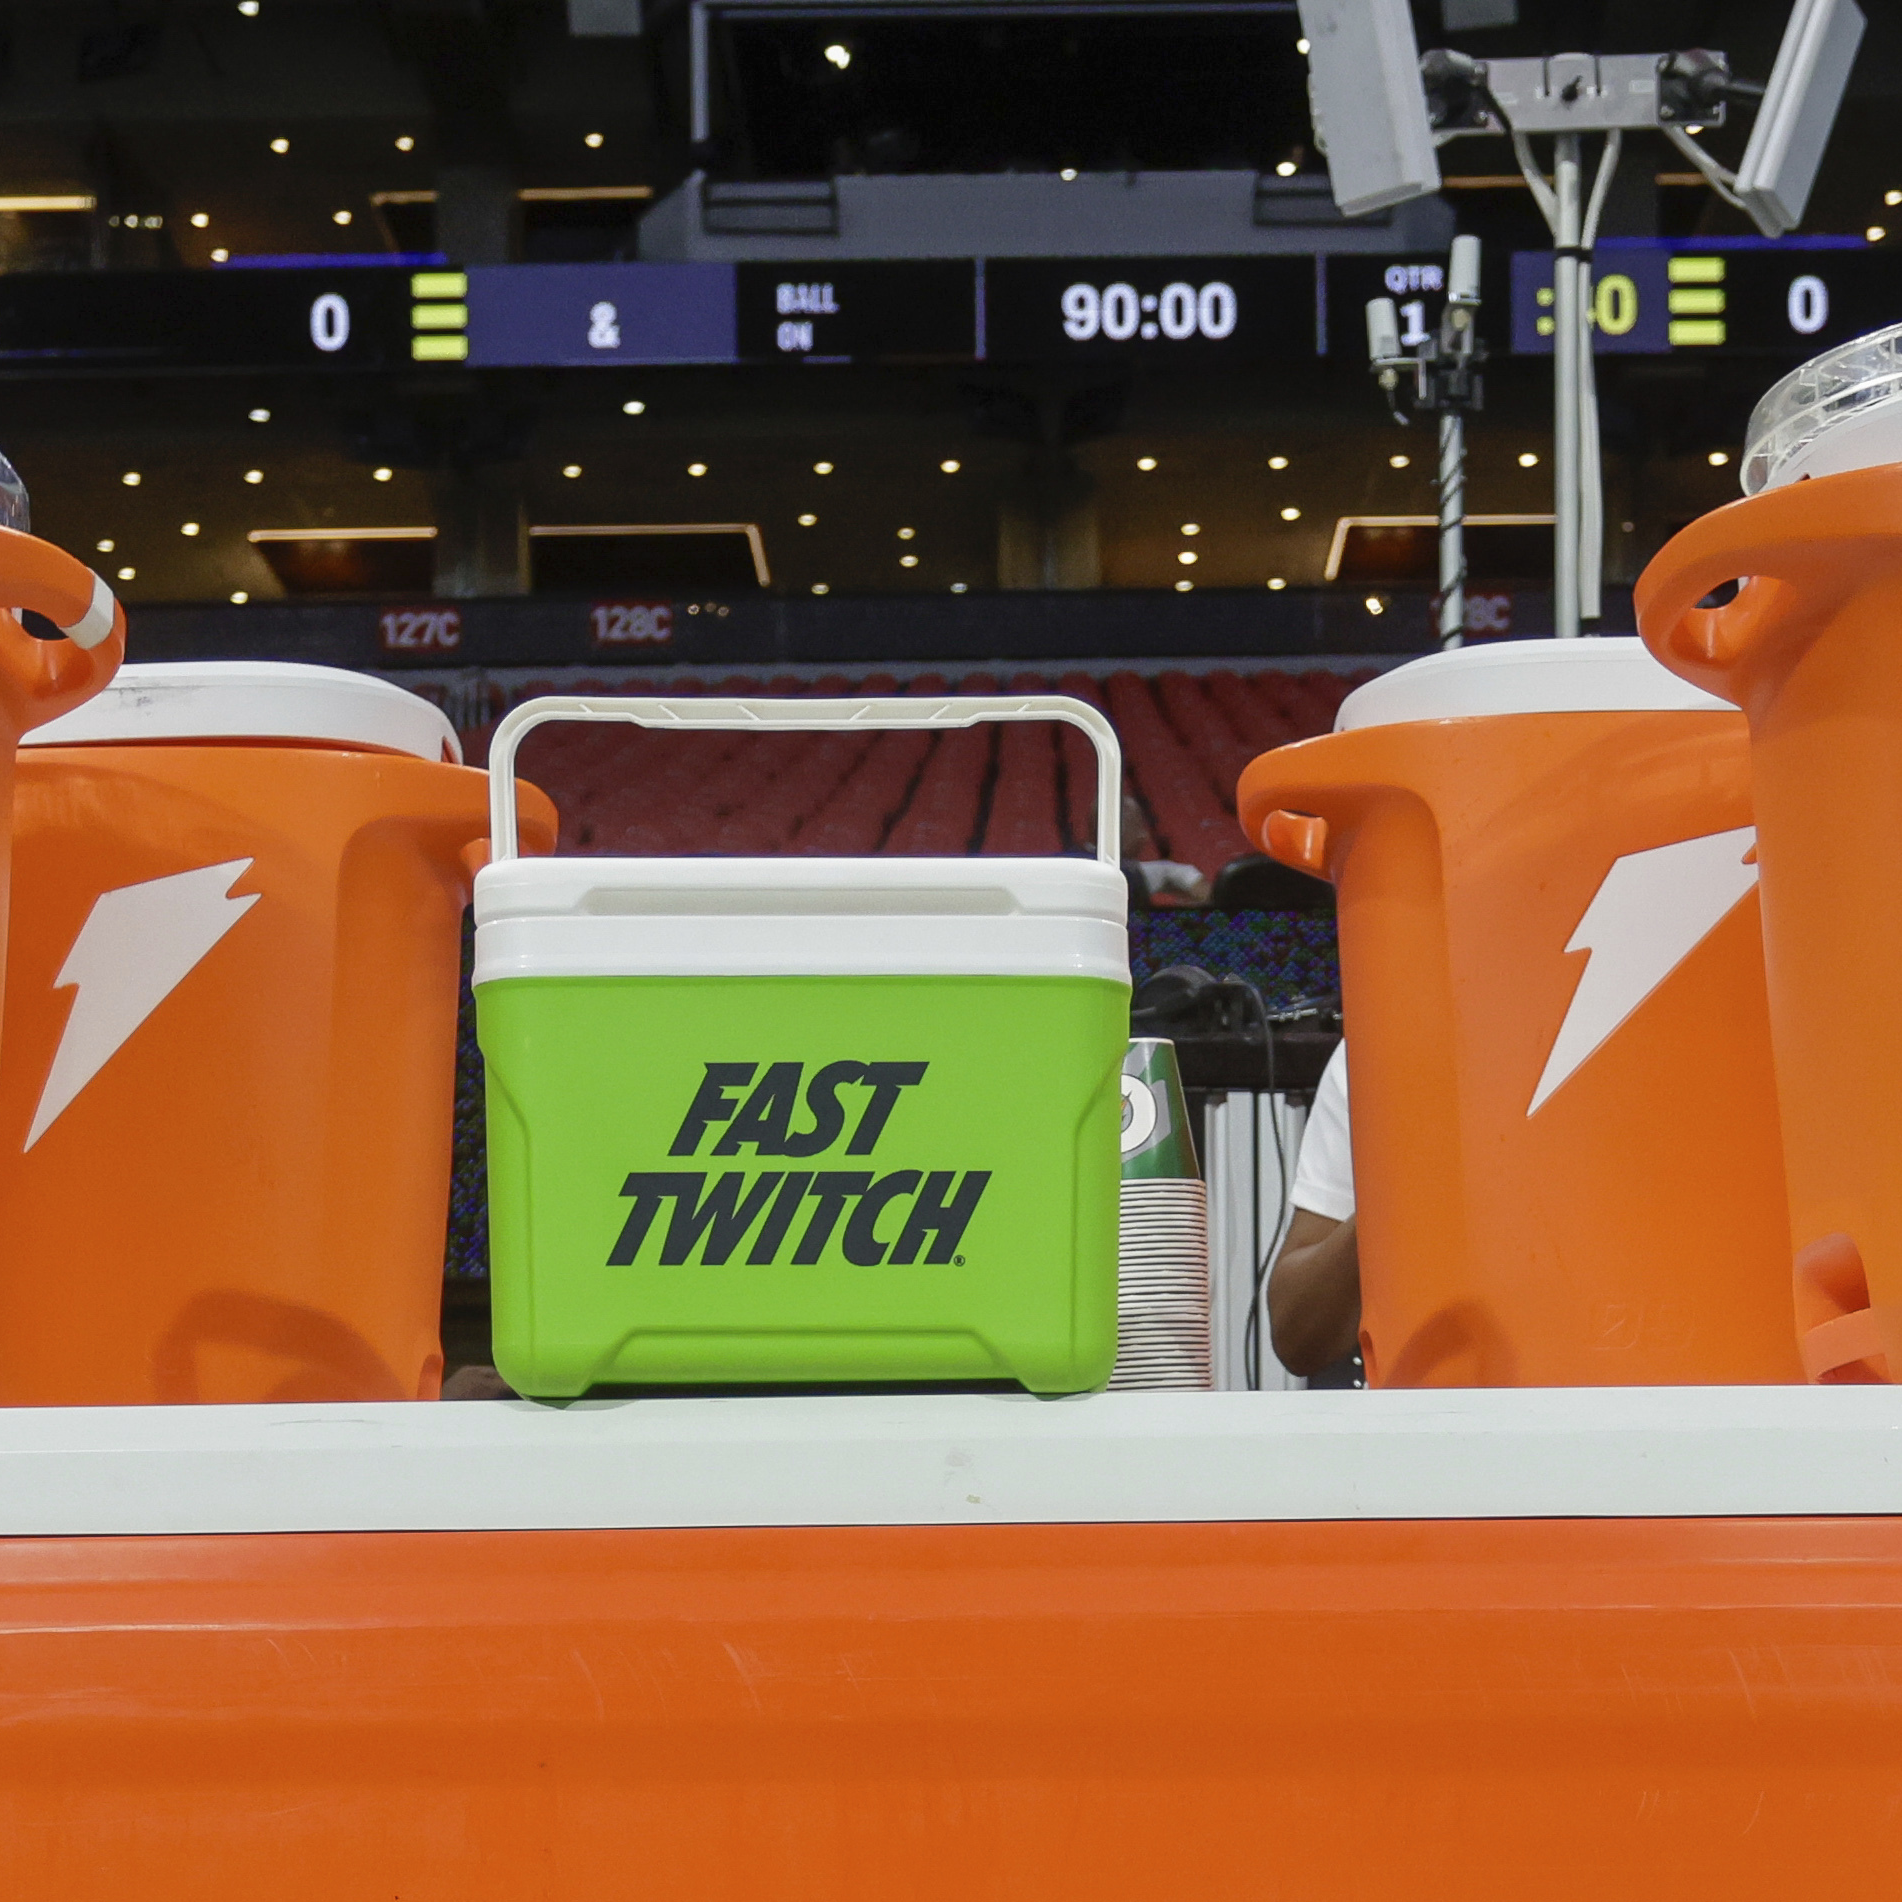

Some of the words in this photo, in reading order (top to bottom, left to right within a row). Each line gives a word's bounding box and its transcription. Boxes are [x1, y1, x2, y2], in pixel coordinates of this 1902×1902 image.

[776, 283, 840, 314] BALL
[1385, 264, 1444, 293] QTR
[310, 293, 352, 352] 0
[1061, 282, 1238, 341] 90:00
[1788, 276, 1829, 334] 0
[776, 321, 814, 351] ON
[380, 611, 461, 648] 127C
[591, 605, 673, 641] 128C
[668, 1060, 929, 1157] FAST
[606, 1170, 991, 1267] TWITCH
